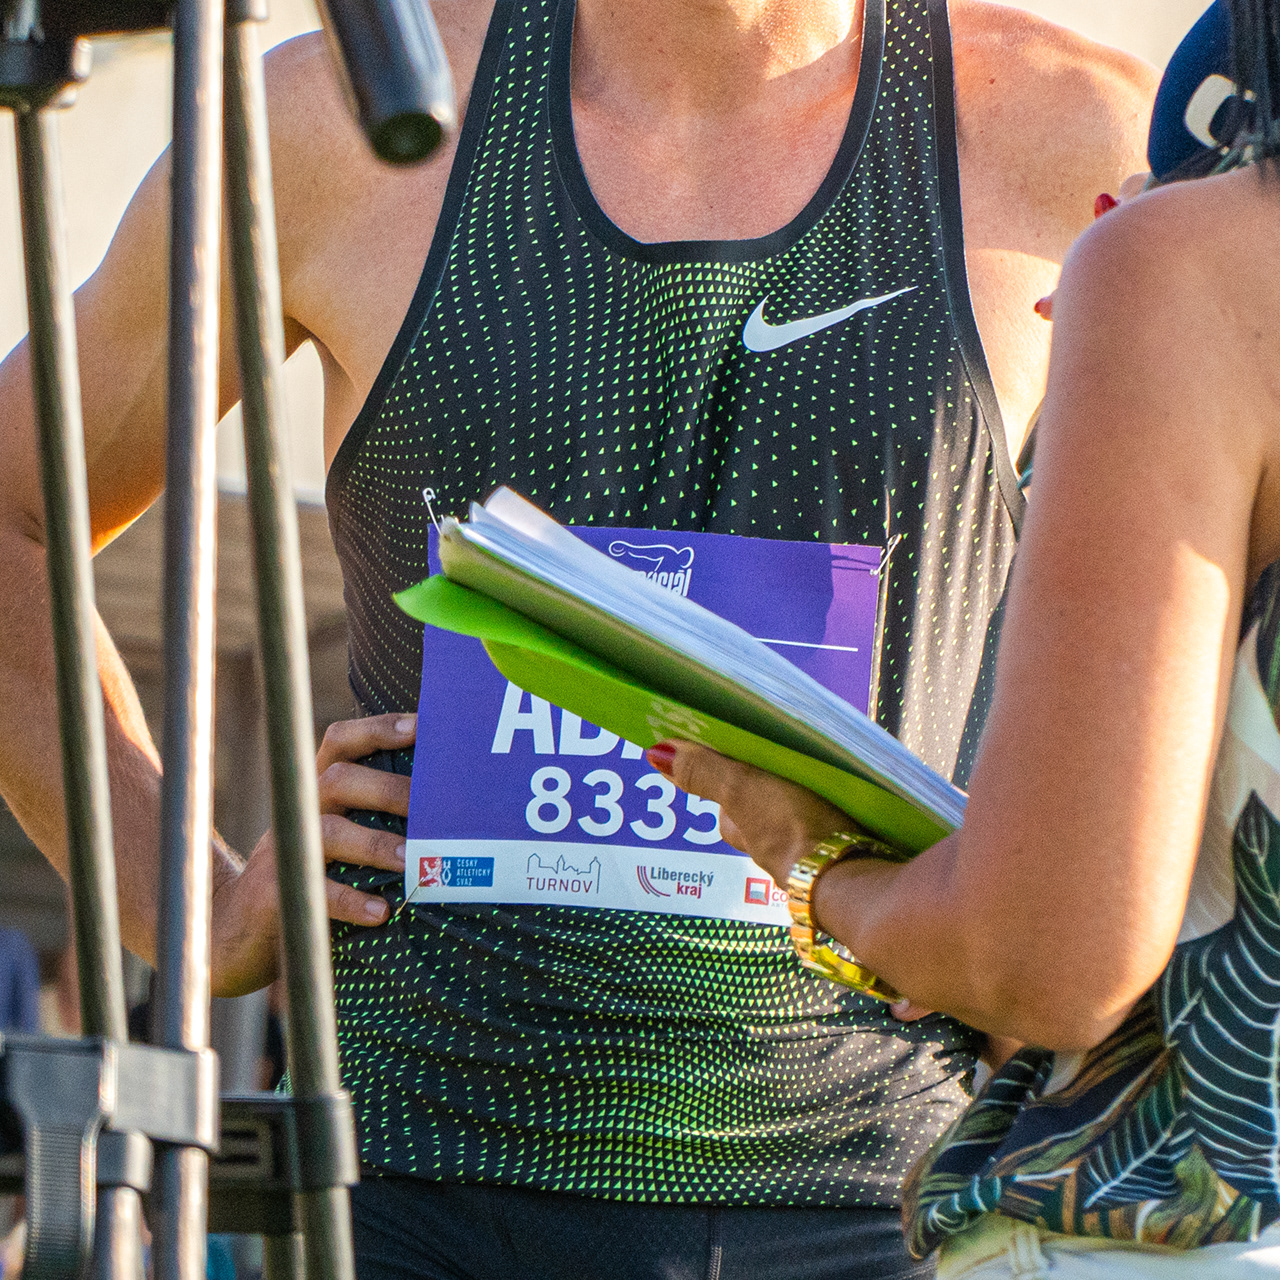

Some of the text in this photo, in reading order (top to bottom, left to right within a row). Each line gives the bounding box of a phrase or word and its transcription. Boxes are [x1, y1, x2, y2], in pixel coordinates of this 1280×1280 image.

[456, 877, 473, 886] SVAZ
[526, 877, 593, 893] TURNOV
[650, 867, 714, 887] Liberecký
[676, 882, 702, 899] kraj
